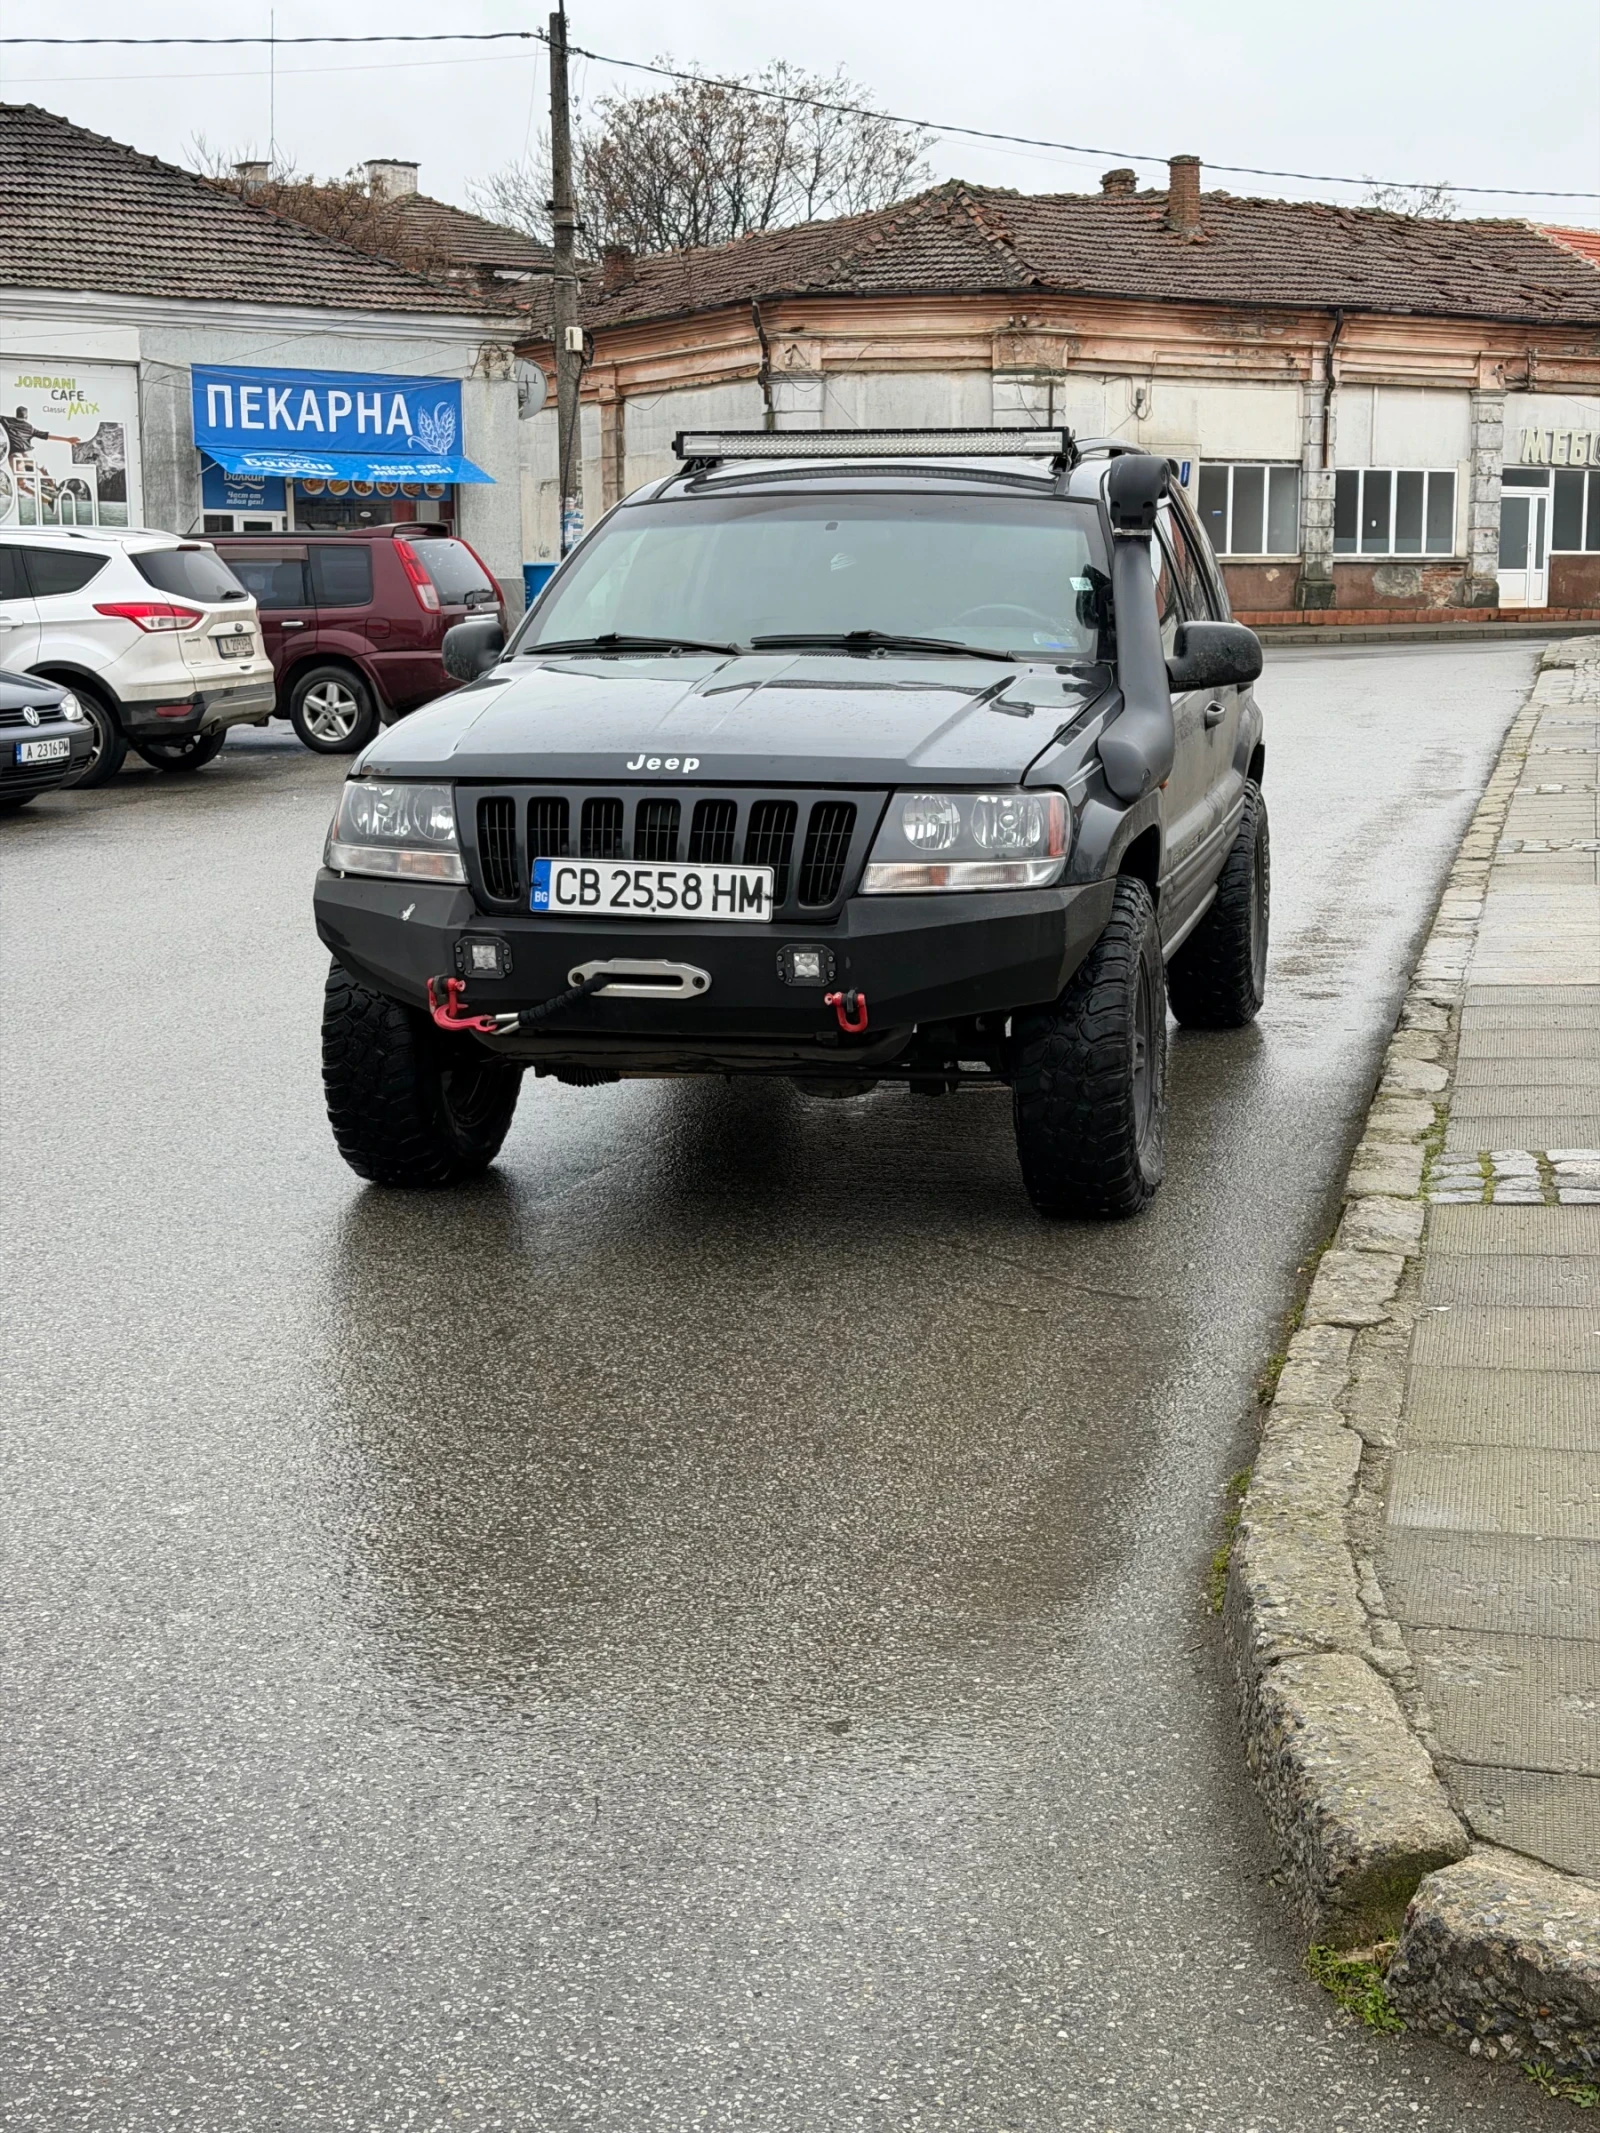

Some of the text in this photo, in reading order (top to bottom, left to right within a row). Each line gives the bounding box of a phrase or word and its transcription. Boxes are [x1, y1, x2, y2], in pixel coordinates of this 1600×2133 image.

[50, 389, 85, 401] CAFE
[42, 405, 66, 413] Classic
[206, 384, 413, 436] ПЕКАРНА
[26, 740, 69, 759] A 2316 PM
[626, 754, 700, 774] Jeep
[534, 891, 548, 903] BG
[556, 867, 763, 914] CB 2558 HM
